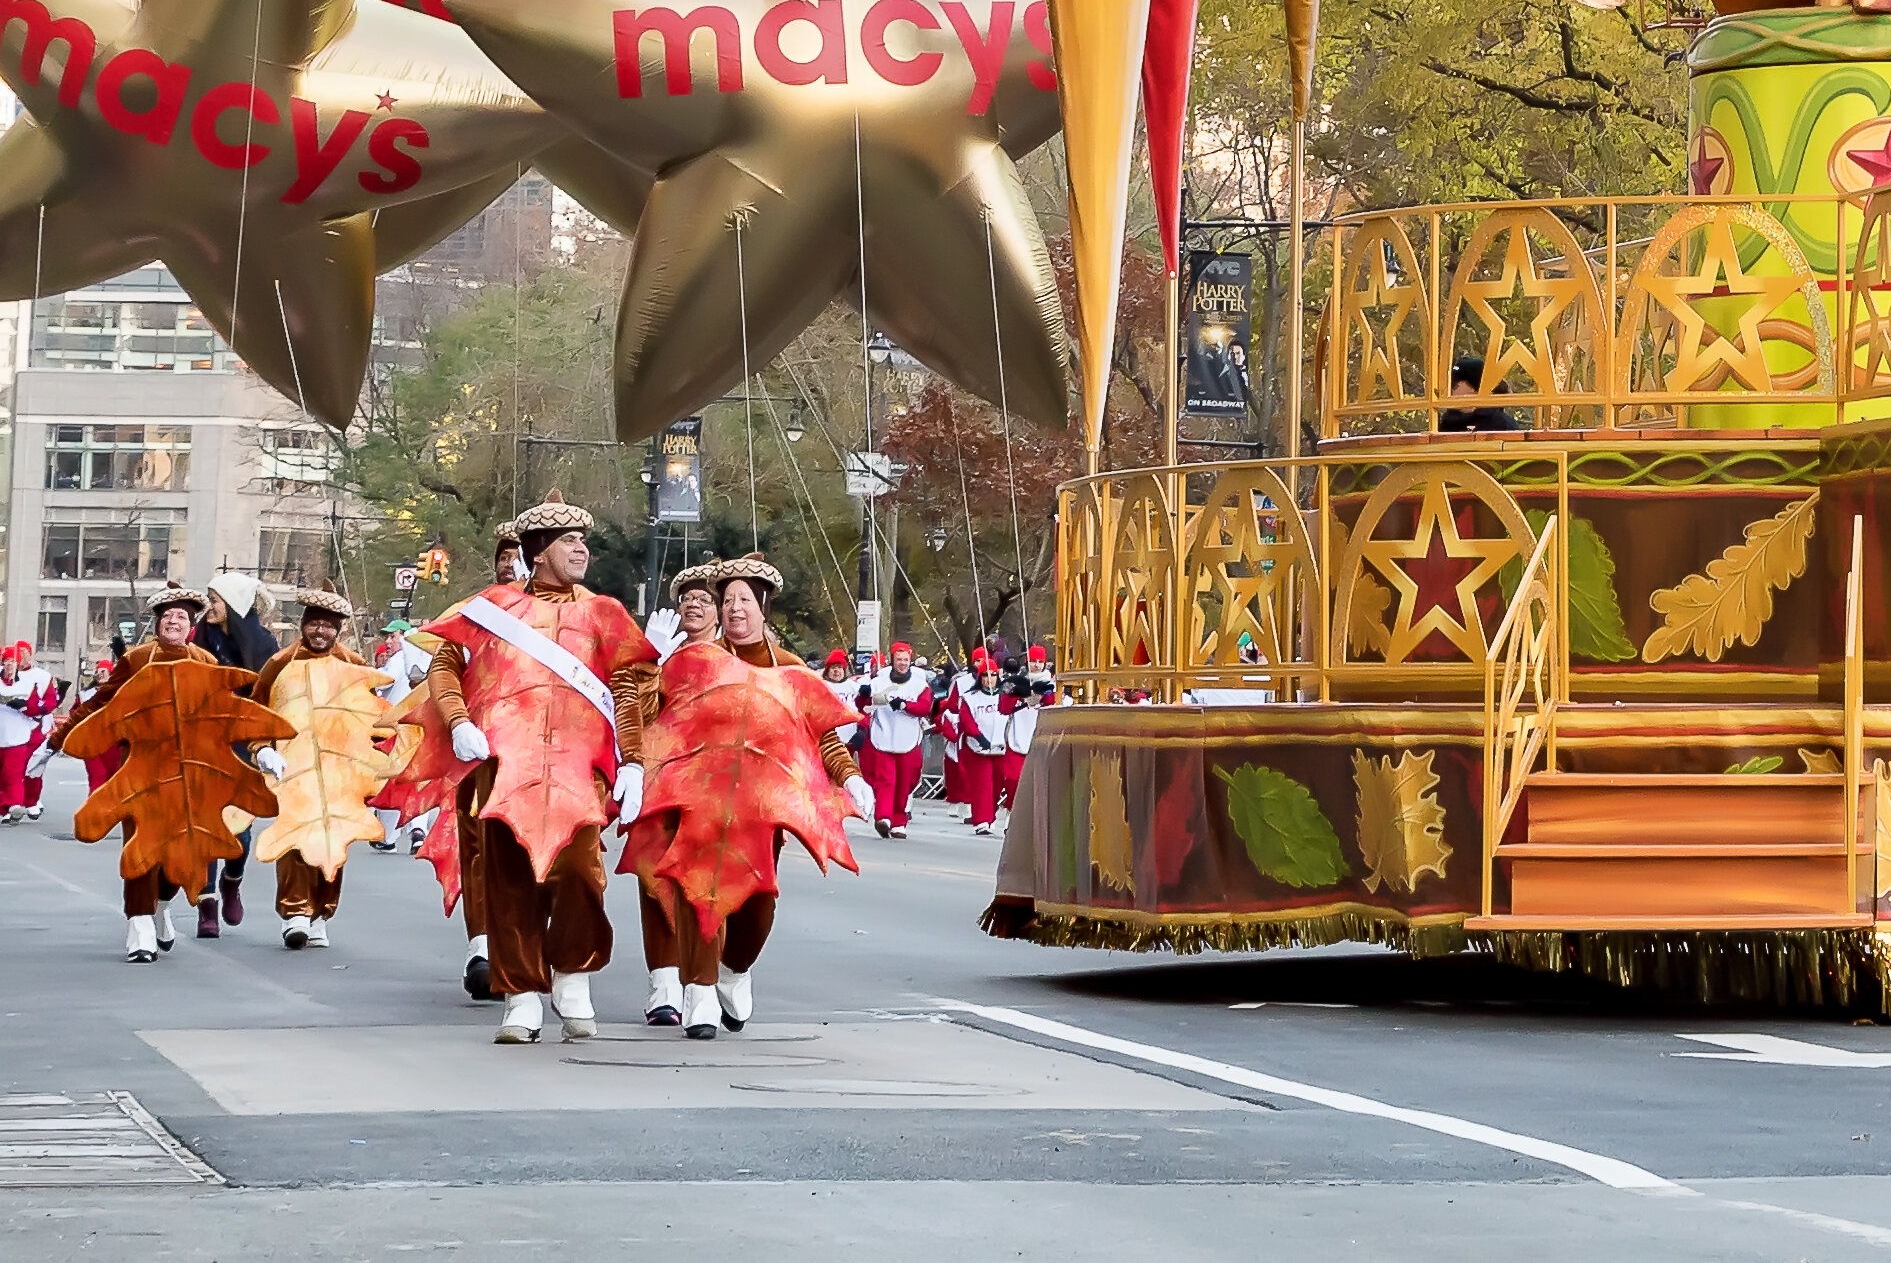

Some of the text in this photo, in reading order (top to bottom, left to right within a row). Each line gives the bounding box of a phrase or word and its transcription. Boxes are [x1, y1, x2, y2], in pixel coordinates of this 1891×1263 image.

[1196, 280, 1246, 298] HARRY
[1192, 295, 1248, 312] POTTER
[1202, 399, 1246, 409] BROADWAY
